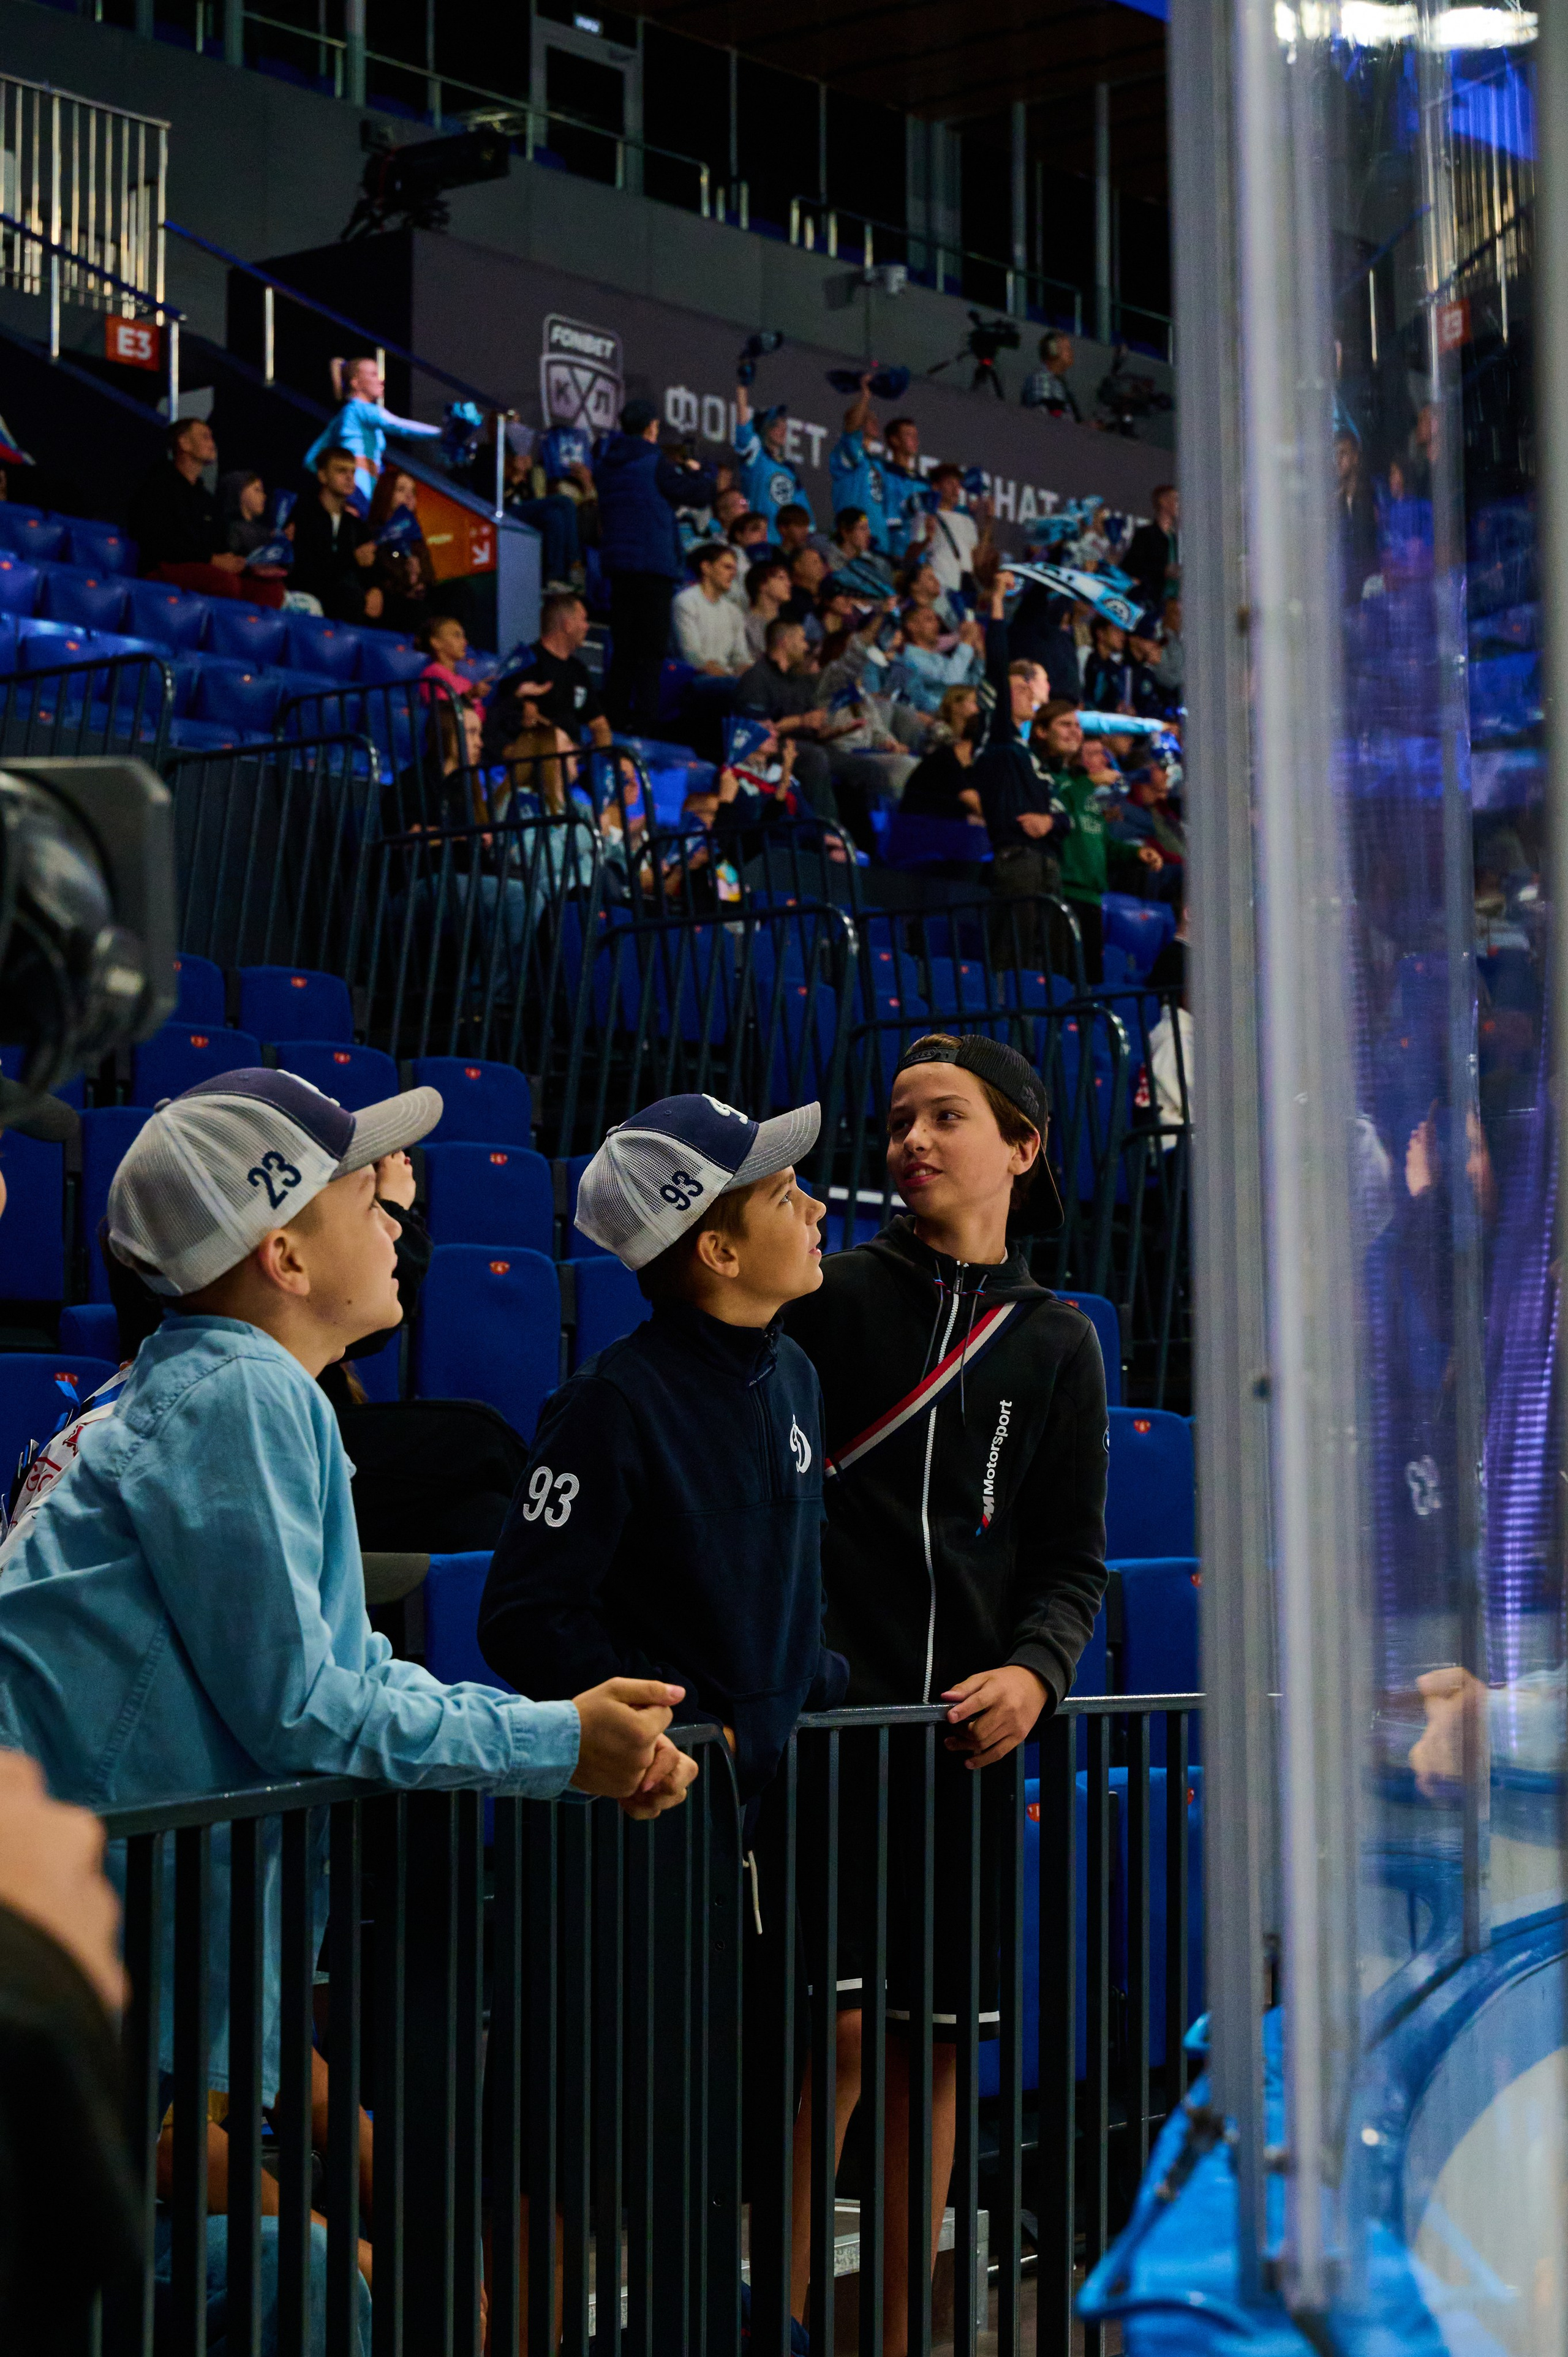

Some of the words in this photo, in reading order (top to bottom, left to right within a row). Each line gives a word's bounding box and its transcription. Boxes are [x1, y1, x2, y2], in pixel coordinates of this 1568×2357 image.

[117, 325, 151, 360] E3
[247, 1151, 301, 1209] 23
[660, 1171, 703, 1210] 93
[983, 1399, 1012, 1495] Motorsport
[522, 1466, 579, 1527] 93
